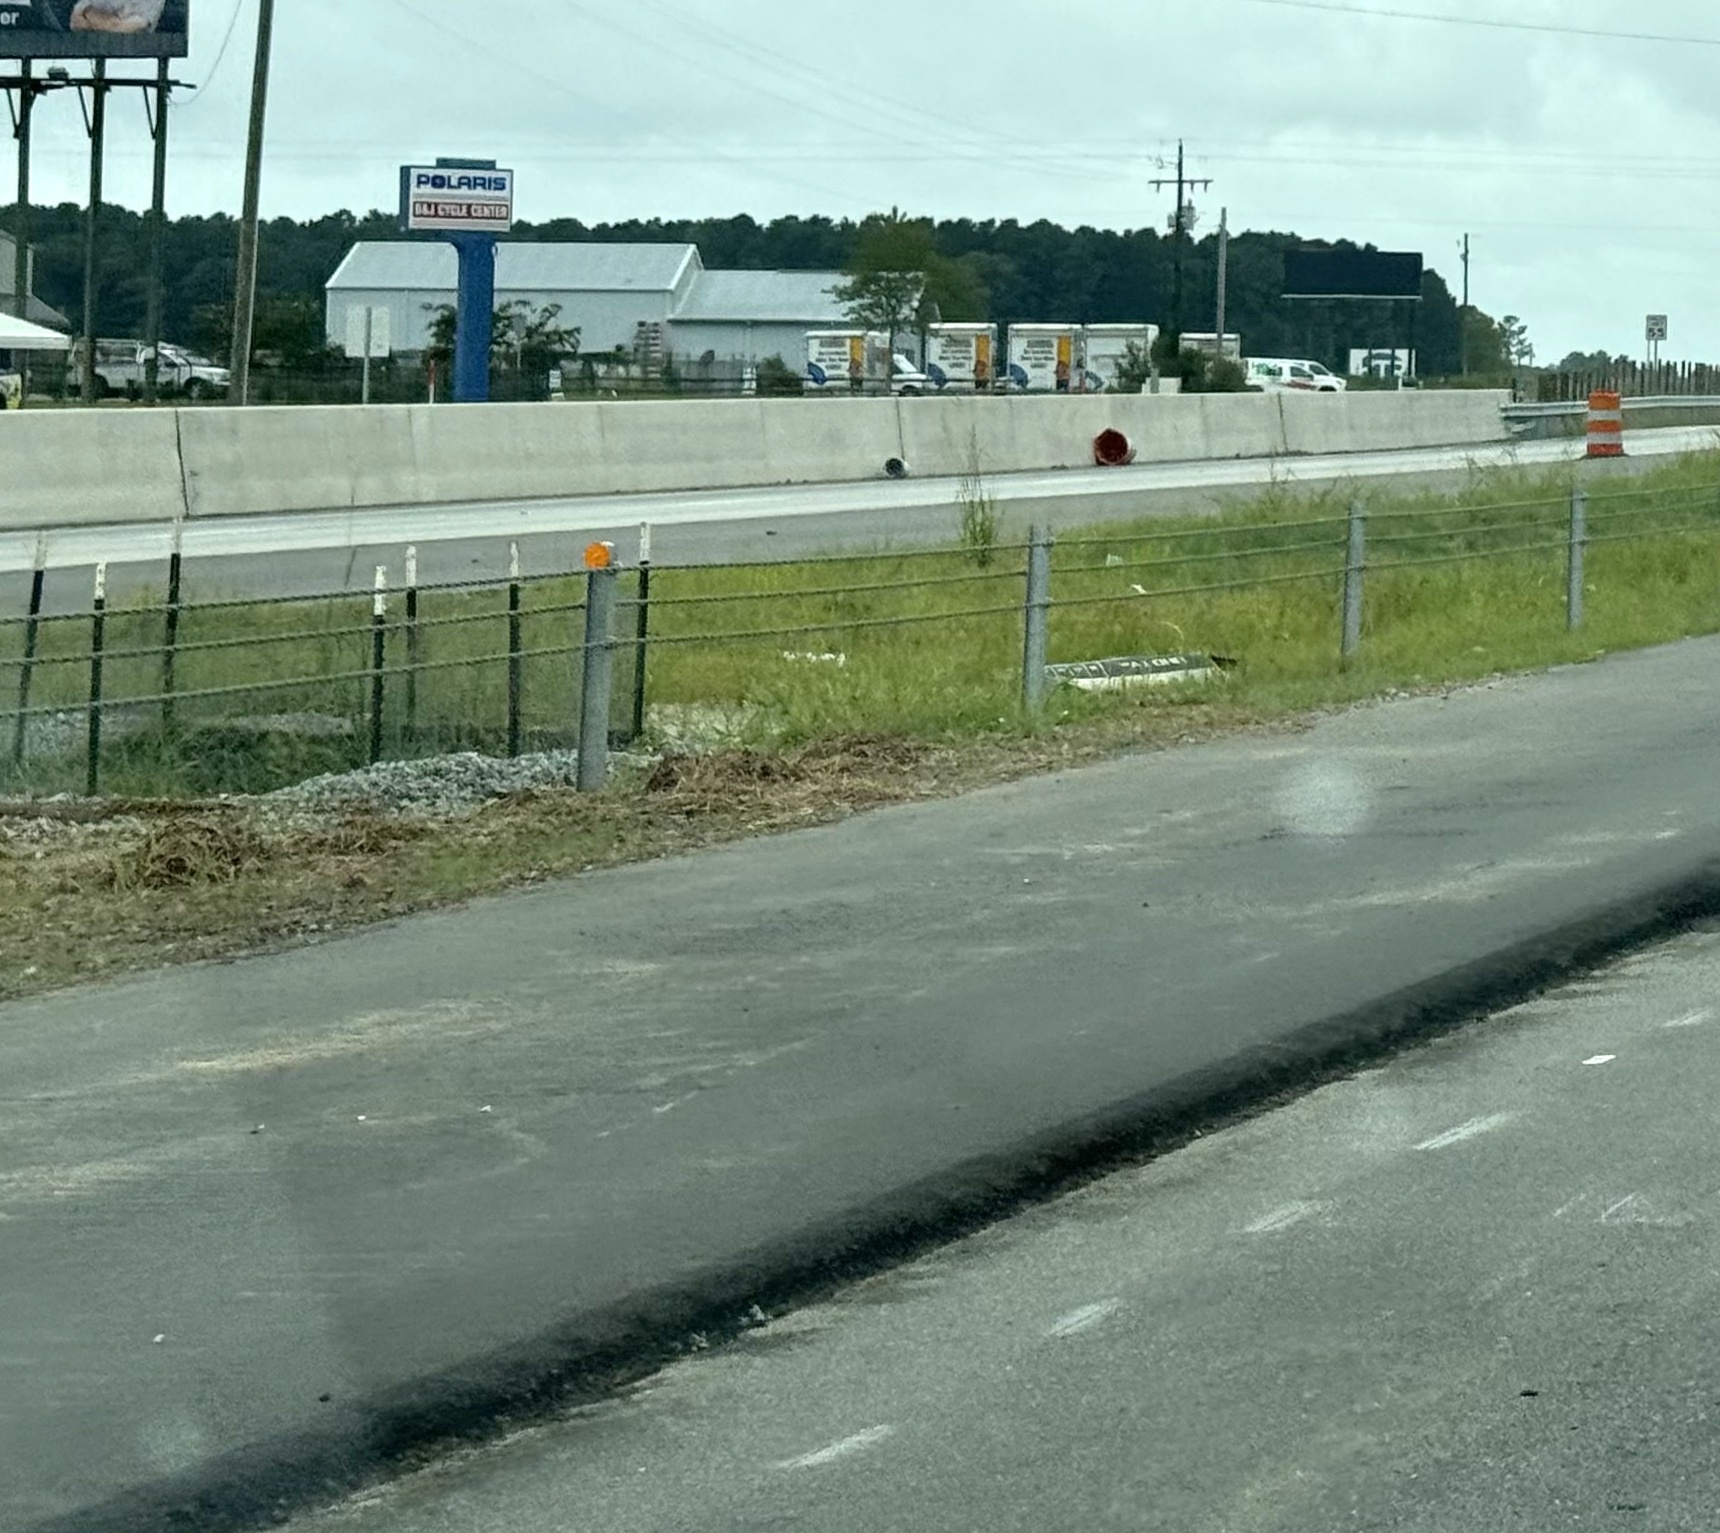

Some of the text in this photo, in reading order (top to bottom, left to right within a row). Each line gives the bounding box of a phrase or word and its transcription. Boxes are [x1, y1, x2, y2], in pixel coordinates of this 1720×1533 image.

[416, 173, 507, 192] POLARIS
[437, 203, 469, 217] CYCLE
[471, 204, 508, 219] CENTER
